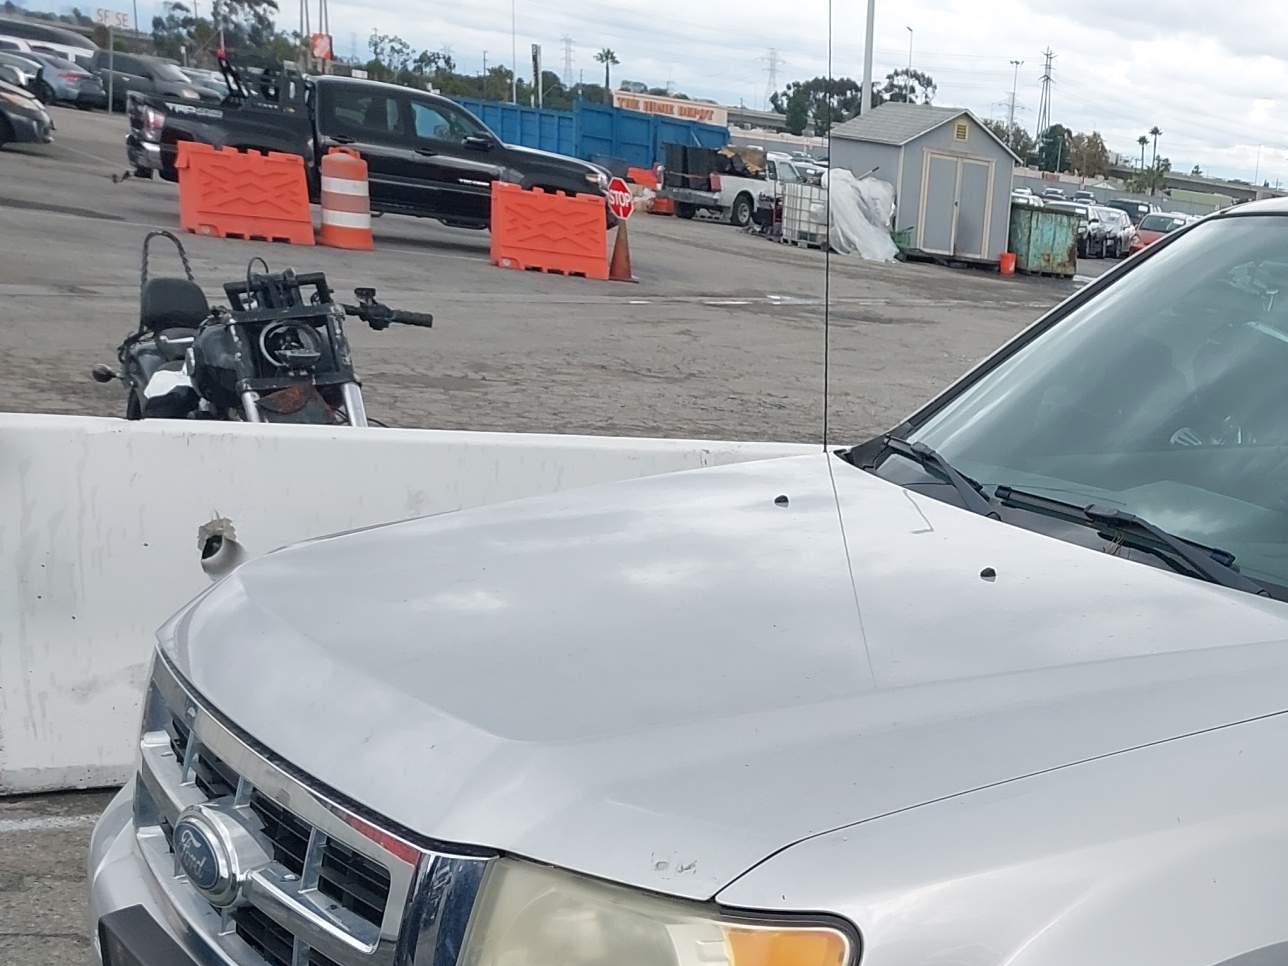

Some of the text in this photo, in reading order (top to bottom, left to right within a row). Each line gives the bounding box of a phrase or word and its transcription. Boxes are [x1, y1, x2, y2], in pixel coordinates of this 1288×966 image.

[617, 96, 714, 121] THE HOME DEPOT
[608, 189, 631, 207] STOP
[178, 829, 207, 879] Ford
